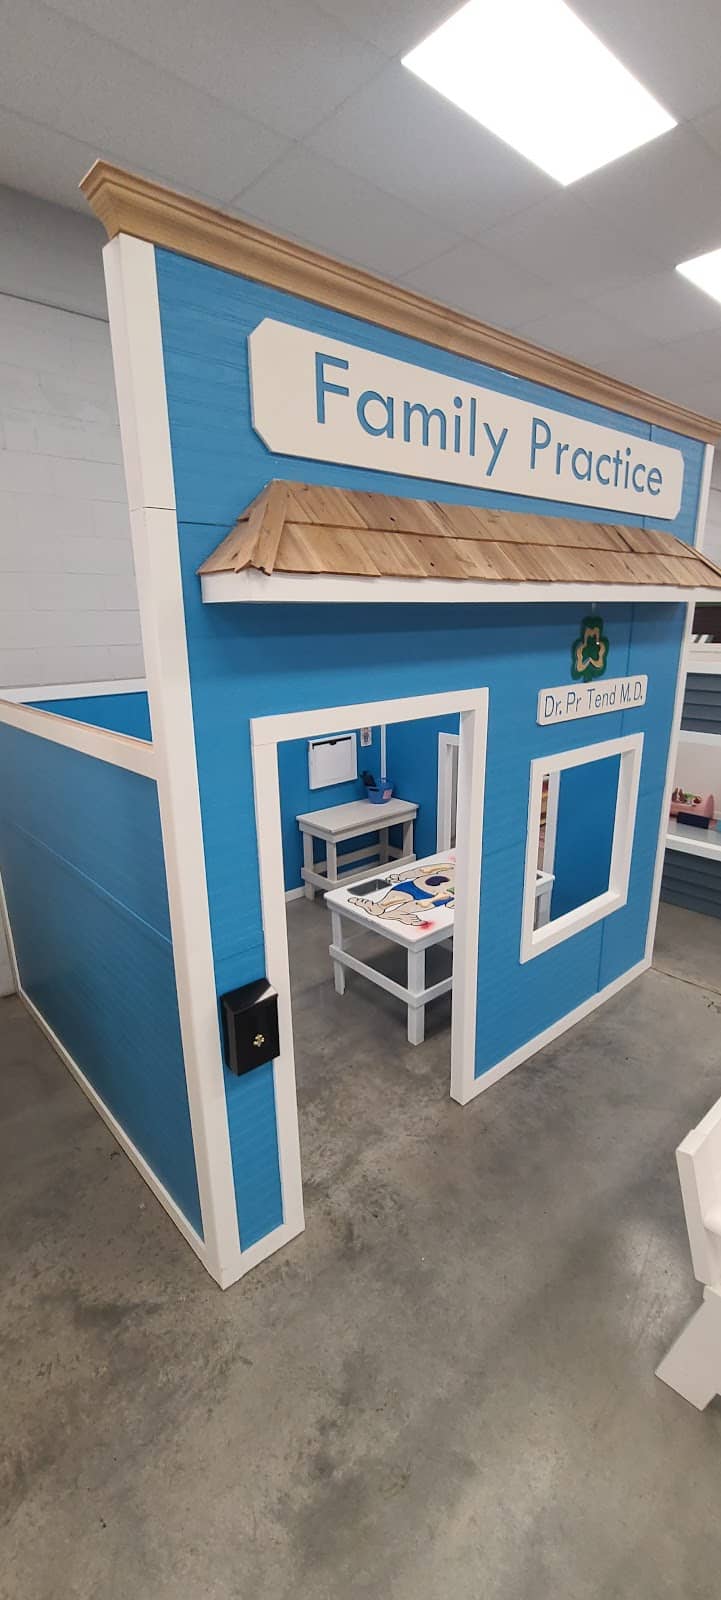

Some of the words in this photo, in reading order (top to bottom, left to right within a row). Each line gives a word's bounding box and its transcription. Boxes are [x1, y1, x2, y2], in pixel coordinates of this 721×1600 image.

[314, 351, 508, 477] Family
[530, 417, 663, 496] Practice
[544, 695, 562, 718] Dr.
[566, 691, 582, 714] Pr
[587, 685, 616, 710] Tend
